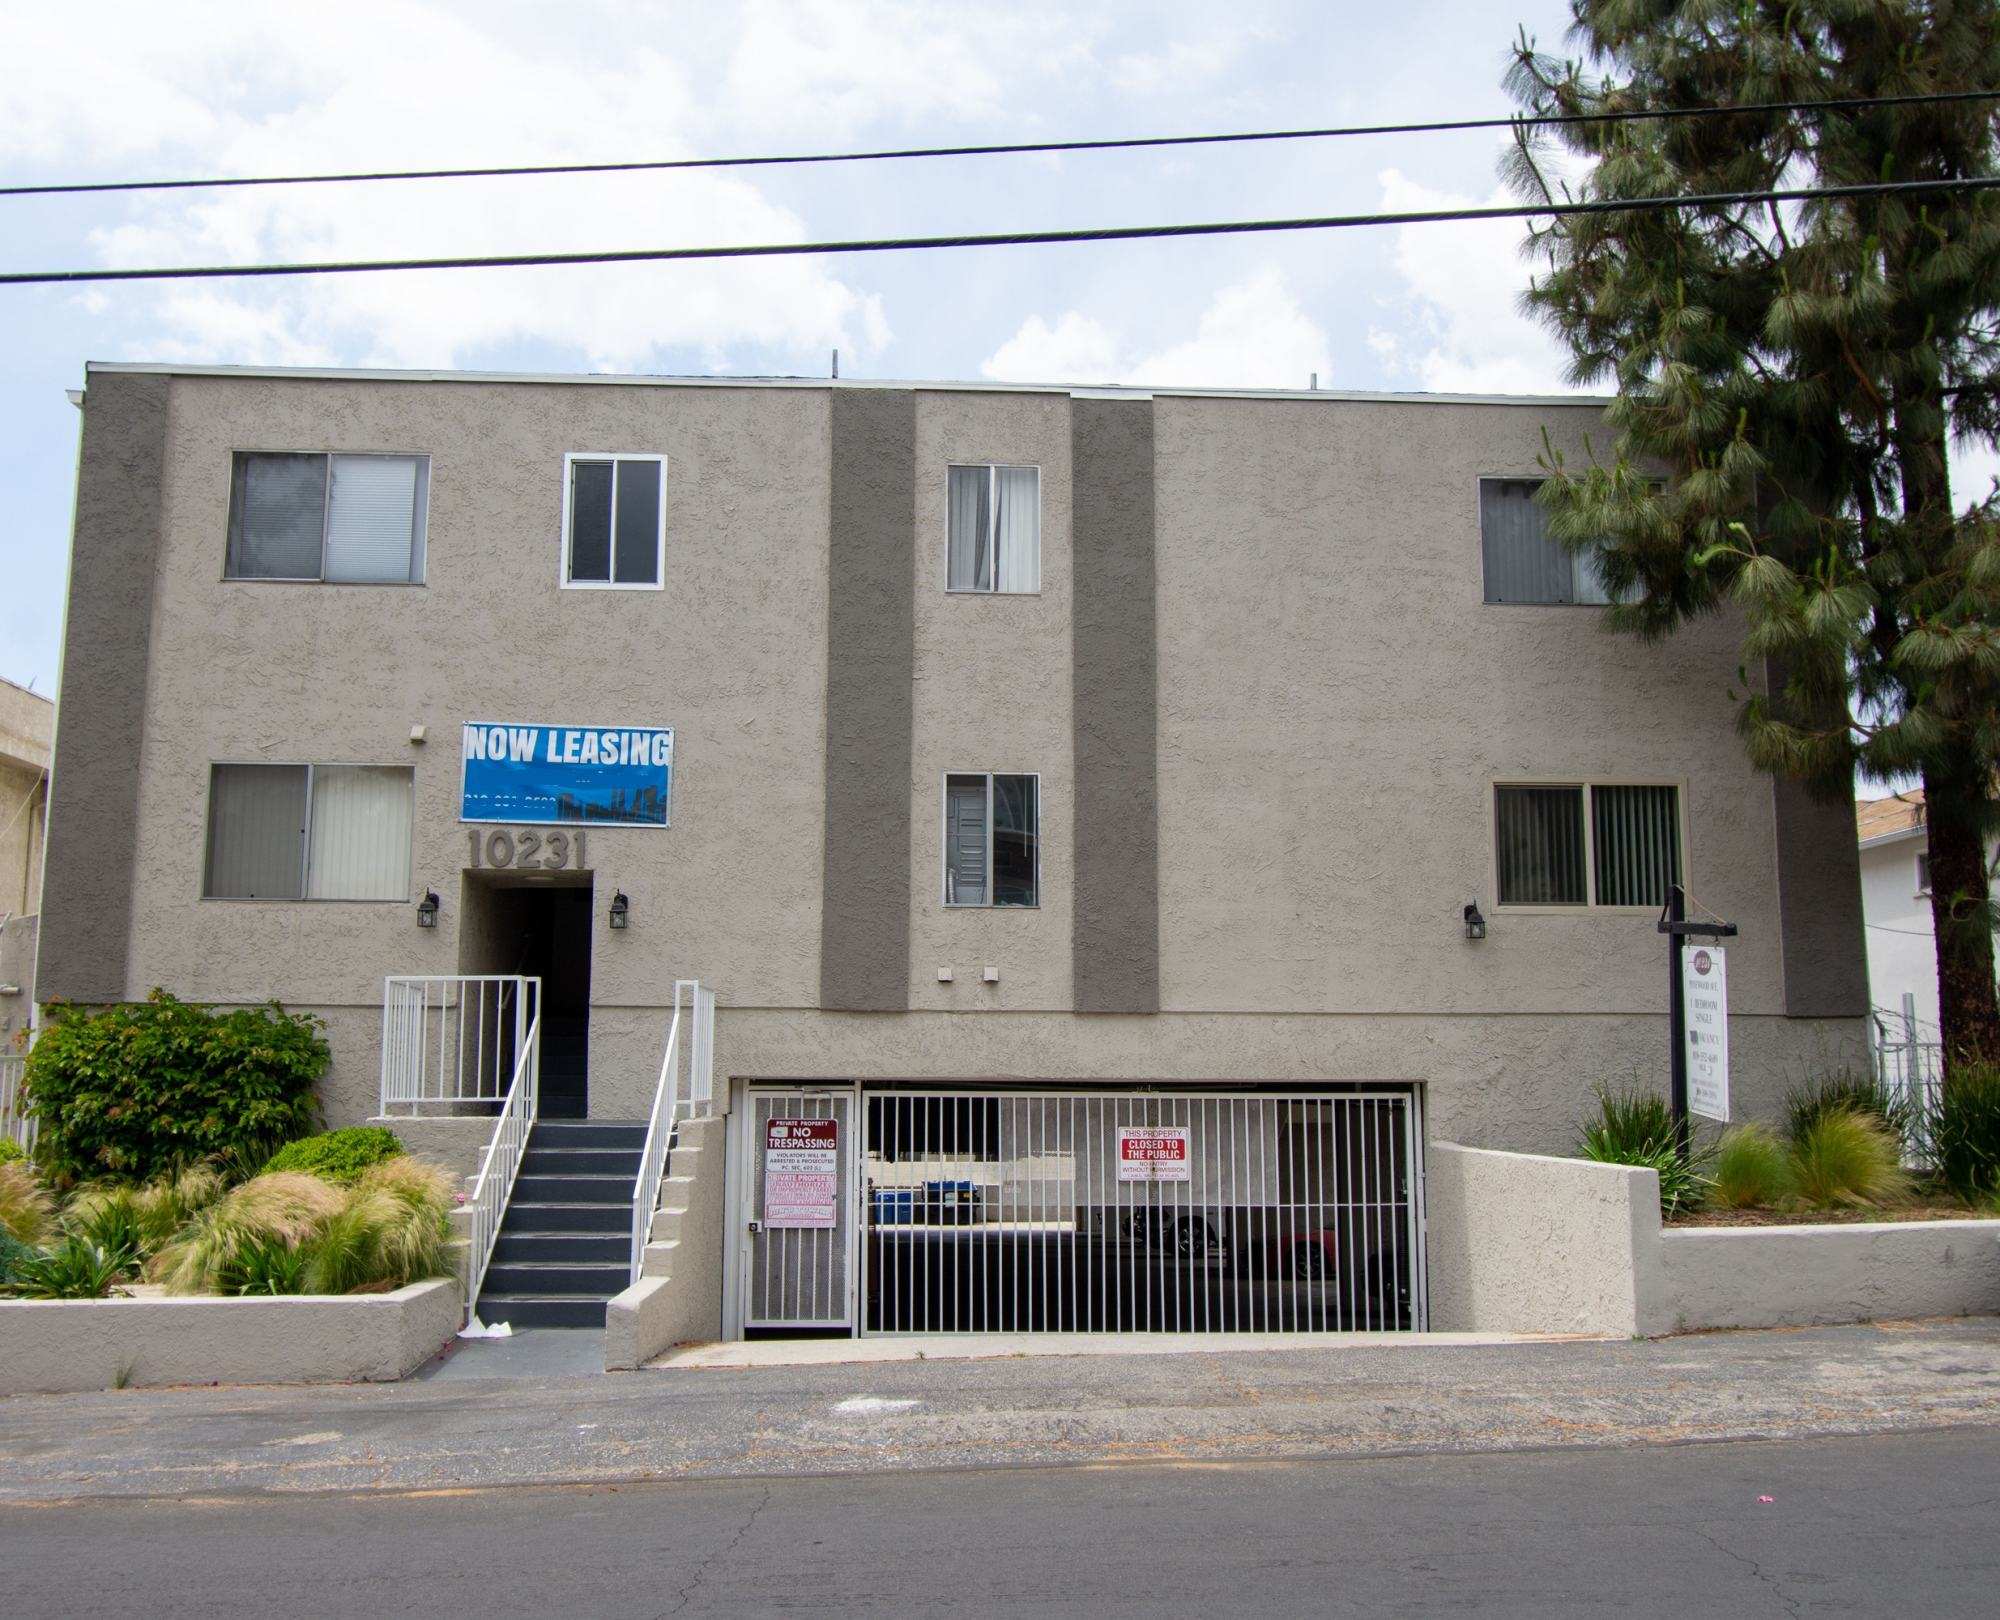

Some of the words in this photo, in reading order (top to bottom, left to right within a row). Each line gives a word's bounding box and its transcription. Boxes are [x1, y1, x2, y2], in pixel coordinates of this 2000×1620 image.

[467, 726, 539, 762] NOW
[547, 730, 671, 767] LEASING
[468, 829, 586, 869] 10231
[792, 1127, 812, 1137] NO
[768, 1138, 835, 1148] TRESPASSING
[1128, 1140, 1164, 1149] CLOSED
[1166, 1140, 1178, 1149] TO
[1127, 1150, 1145, 1159] THE
[1147, 1150, 1180, 1159] PUBLIC
